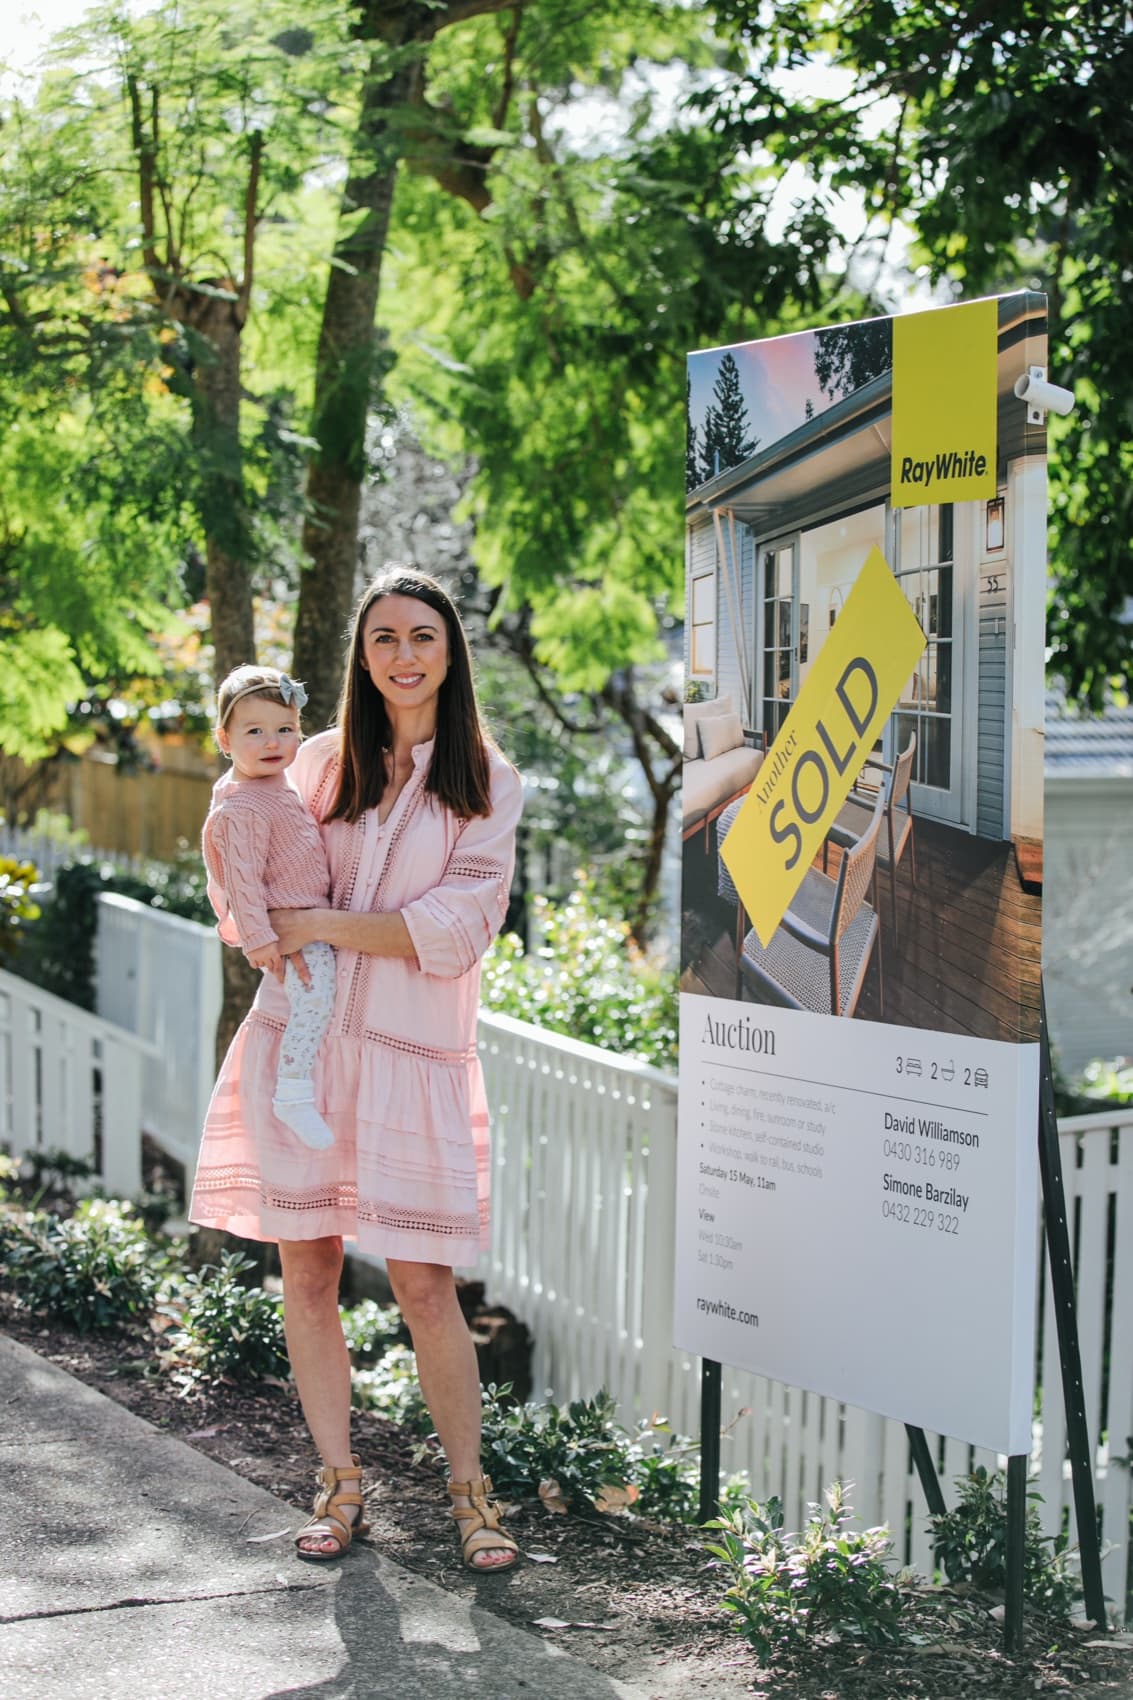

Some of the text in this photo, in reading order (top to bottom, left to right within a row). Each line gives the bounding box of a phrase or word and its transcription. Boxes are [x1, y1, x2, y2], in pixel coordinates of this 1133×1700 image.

[900, 450, 986, 486] RayWhite
[754, 729, 797, 814] Another
[769, 656, 878, 871] SOLD
[701, 1013, 777, 1055] Auction
[895, 1056, 971, 1086] 3 2 2
[884, 1112, 979, 1148] David Williamson
[883, 1139, 960, 1171] 0430 316 989
[699, 1162, 728, 1183] Saturday
[729, 1169, 738, 1182] 15
[757, 1176, 776, 1192] 11am
[883, 1173, 969, 1213] Simone Barzilay
[698, 1207, 716, 1223] View
[882, 1200, 959, 1235] 0432 229 322
[696, 1296, 760, 1328] raywhite.com
